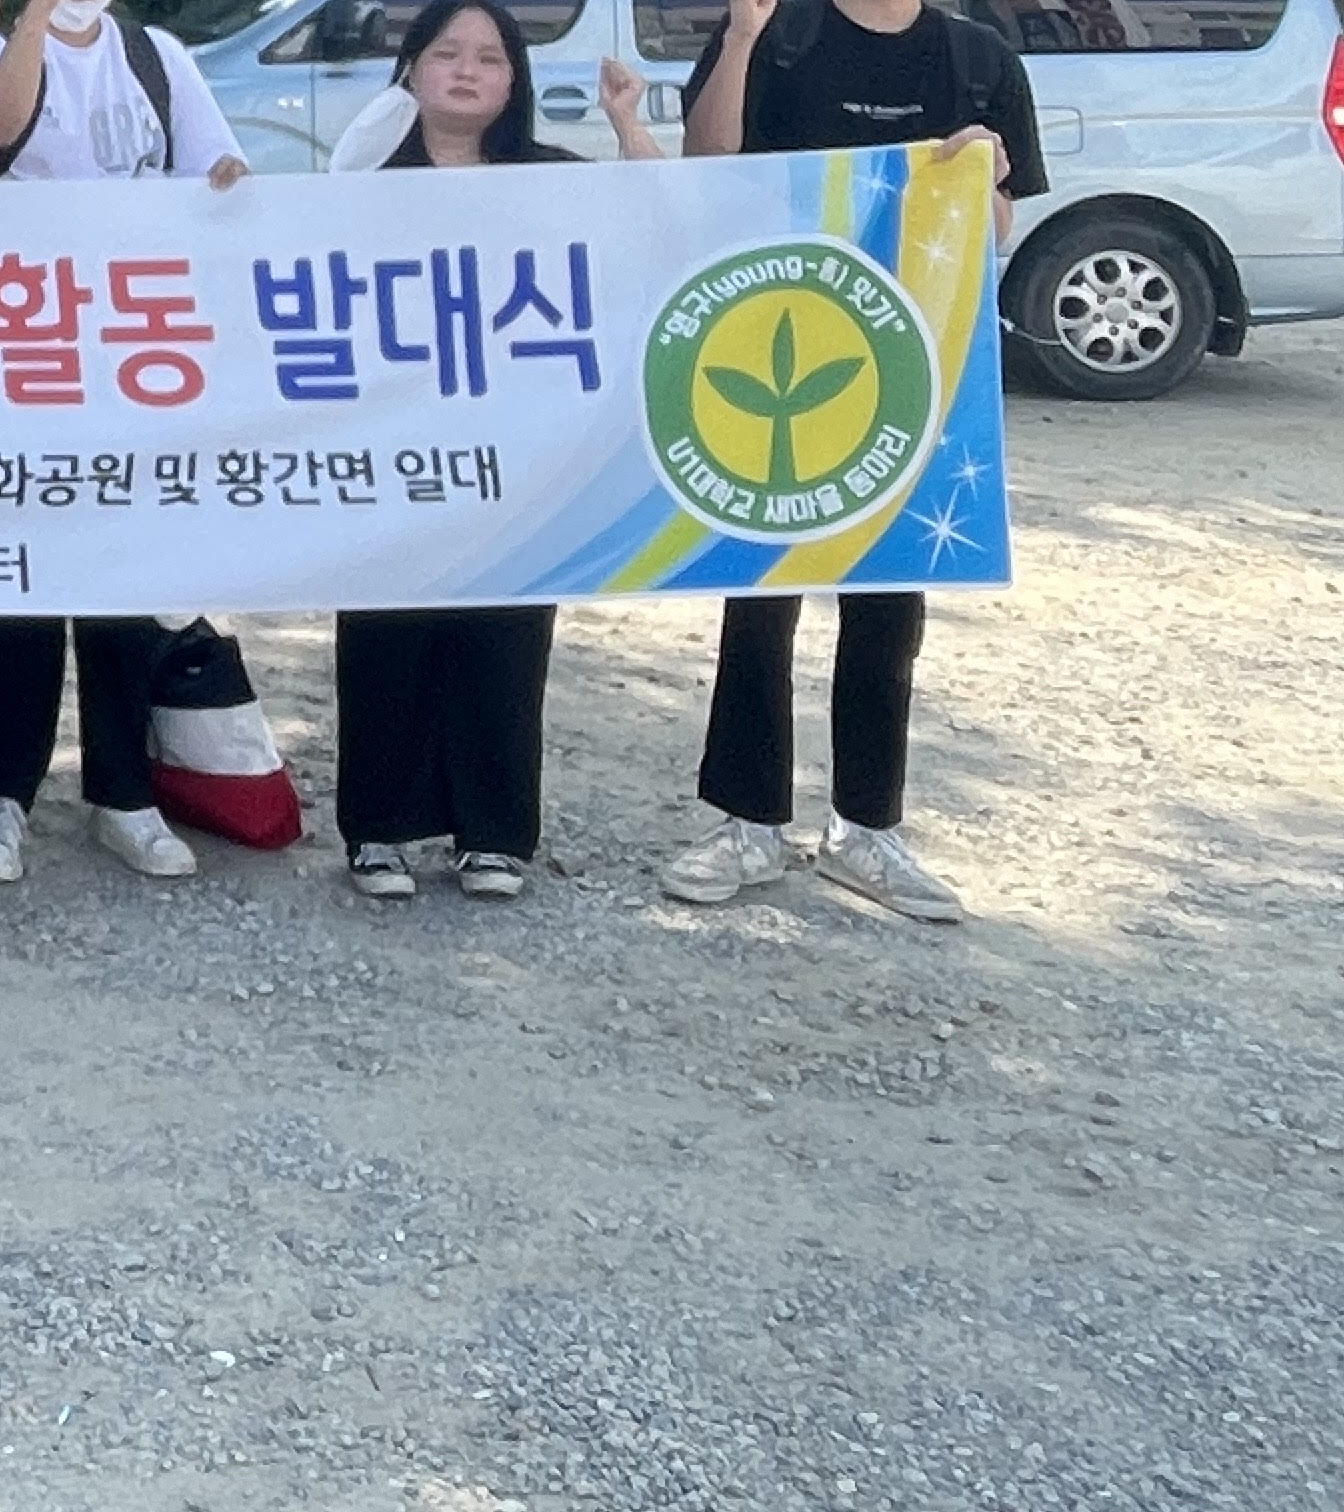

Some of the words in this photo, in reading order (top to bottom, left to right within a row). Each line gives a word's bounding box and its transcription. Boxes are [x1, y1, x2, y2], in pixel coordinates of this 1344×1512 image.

[253, 242, 603, 402] 발대식
[154, 450, 200, 506] 및
[216, 447, 378, 508] 황간면
[394, 443, 503, 503] 일대
